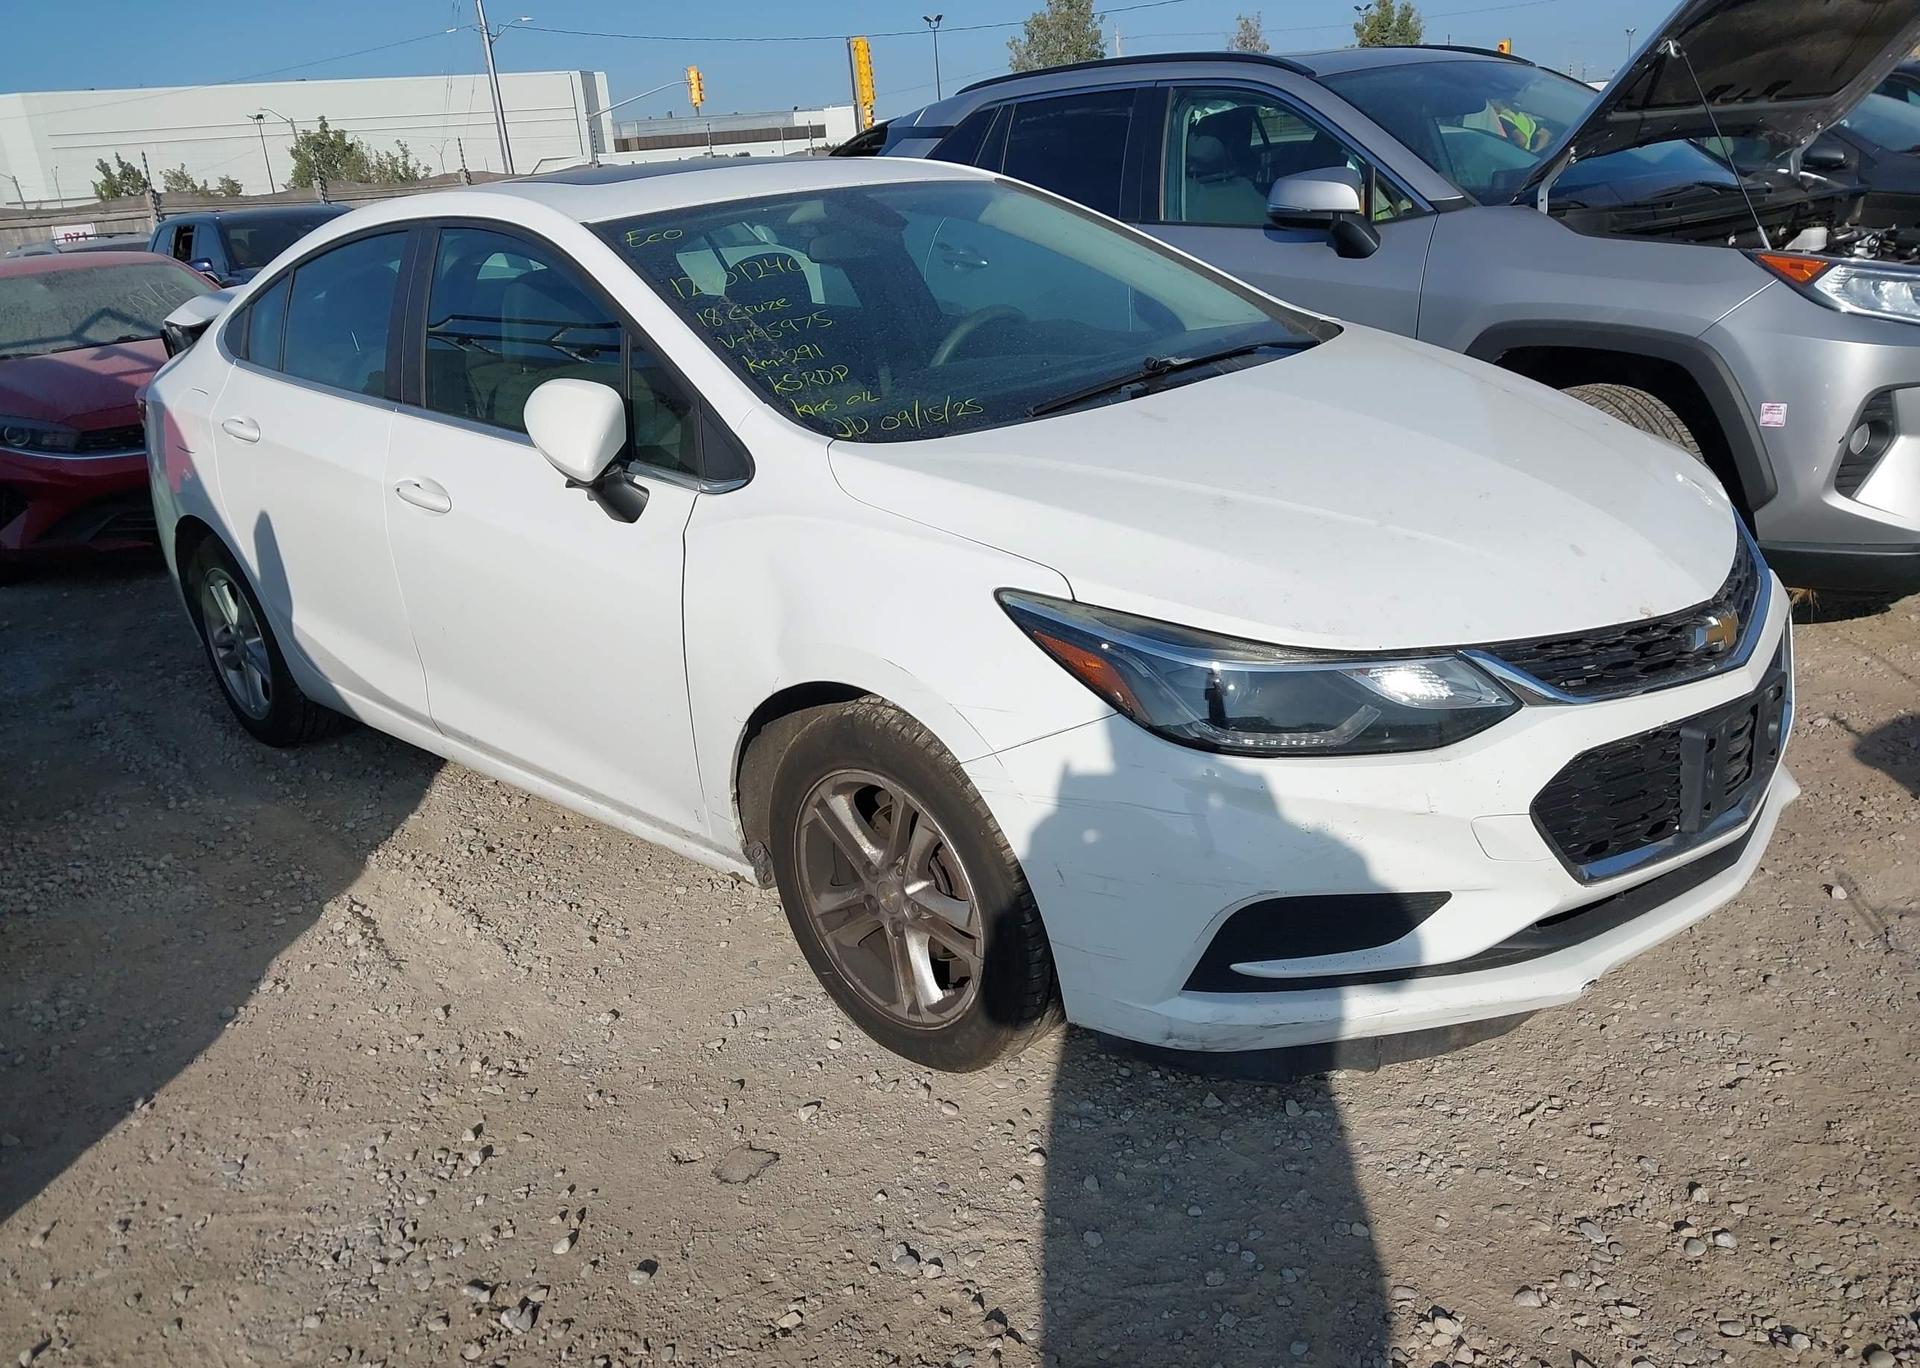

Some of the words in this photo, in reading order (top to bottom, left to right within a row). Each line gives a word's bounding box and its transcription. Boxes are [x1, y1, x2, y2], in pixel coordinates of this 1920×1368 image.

[696, 307, 723, 328] 18
[728, 297, 792, 321] Cruze
[880, 395, 984, 431] 09/15/25
